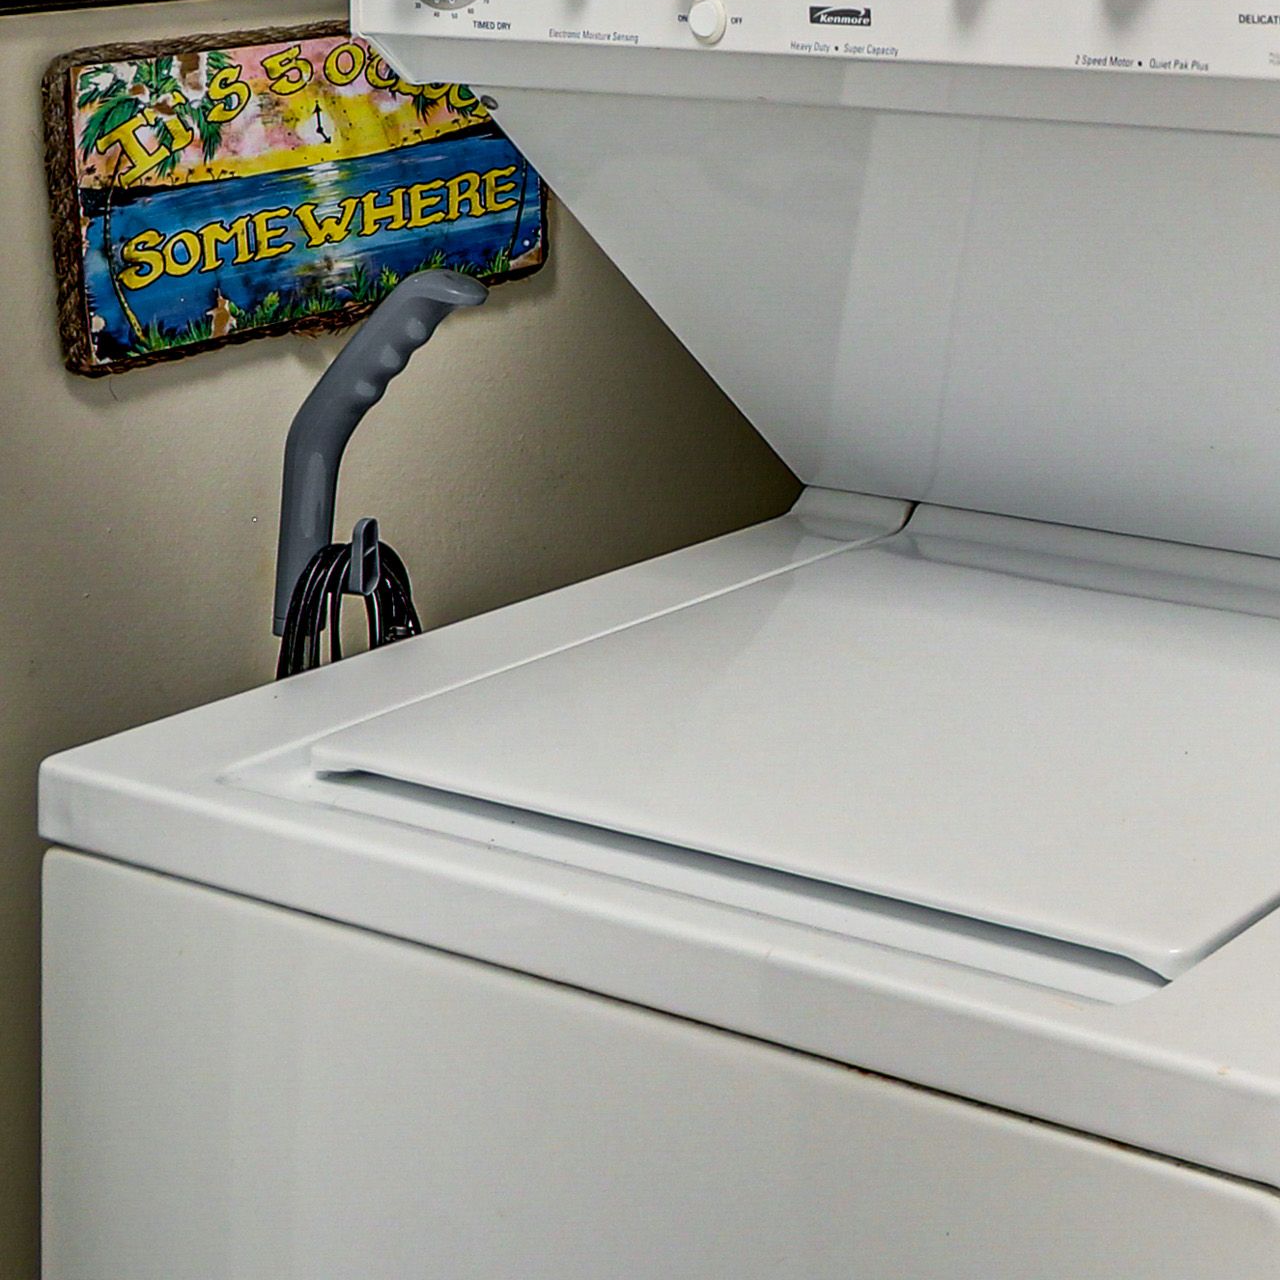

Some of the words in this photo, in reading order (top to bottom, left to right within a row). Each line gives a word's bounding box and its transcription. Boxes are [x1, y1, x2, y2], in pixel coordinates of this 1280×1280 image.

[473, 21, 495, 30] TIMED
[496, 22, 511, 30] DRY
[819, 13, 871, 25] Kenmore
[549, 28, 581, 39] Electronic
[612, 32, 639, 43] Sensing
[790, 42, 812, 53] Heavy
[813, 43, 830, 54] Duty
[843, 44, 865, 55] Super
[866, 45, 899, 57] Capacity
[1082, 55, 1107, 67] Speed
[1108, 56, 1134, 68] Motor
[267, 45, 314, 97] 5
[117, 165, 524, 290] SOMEWHERE
